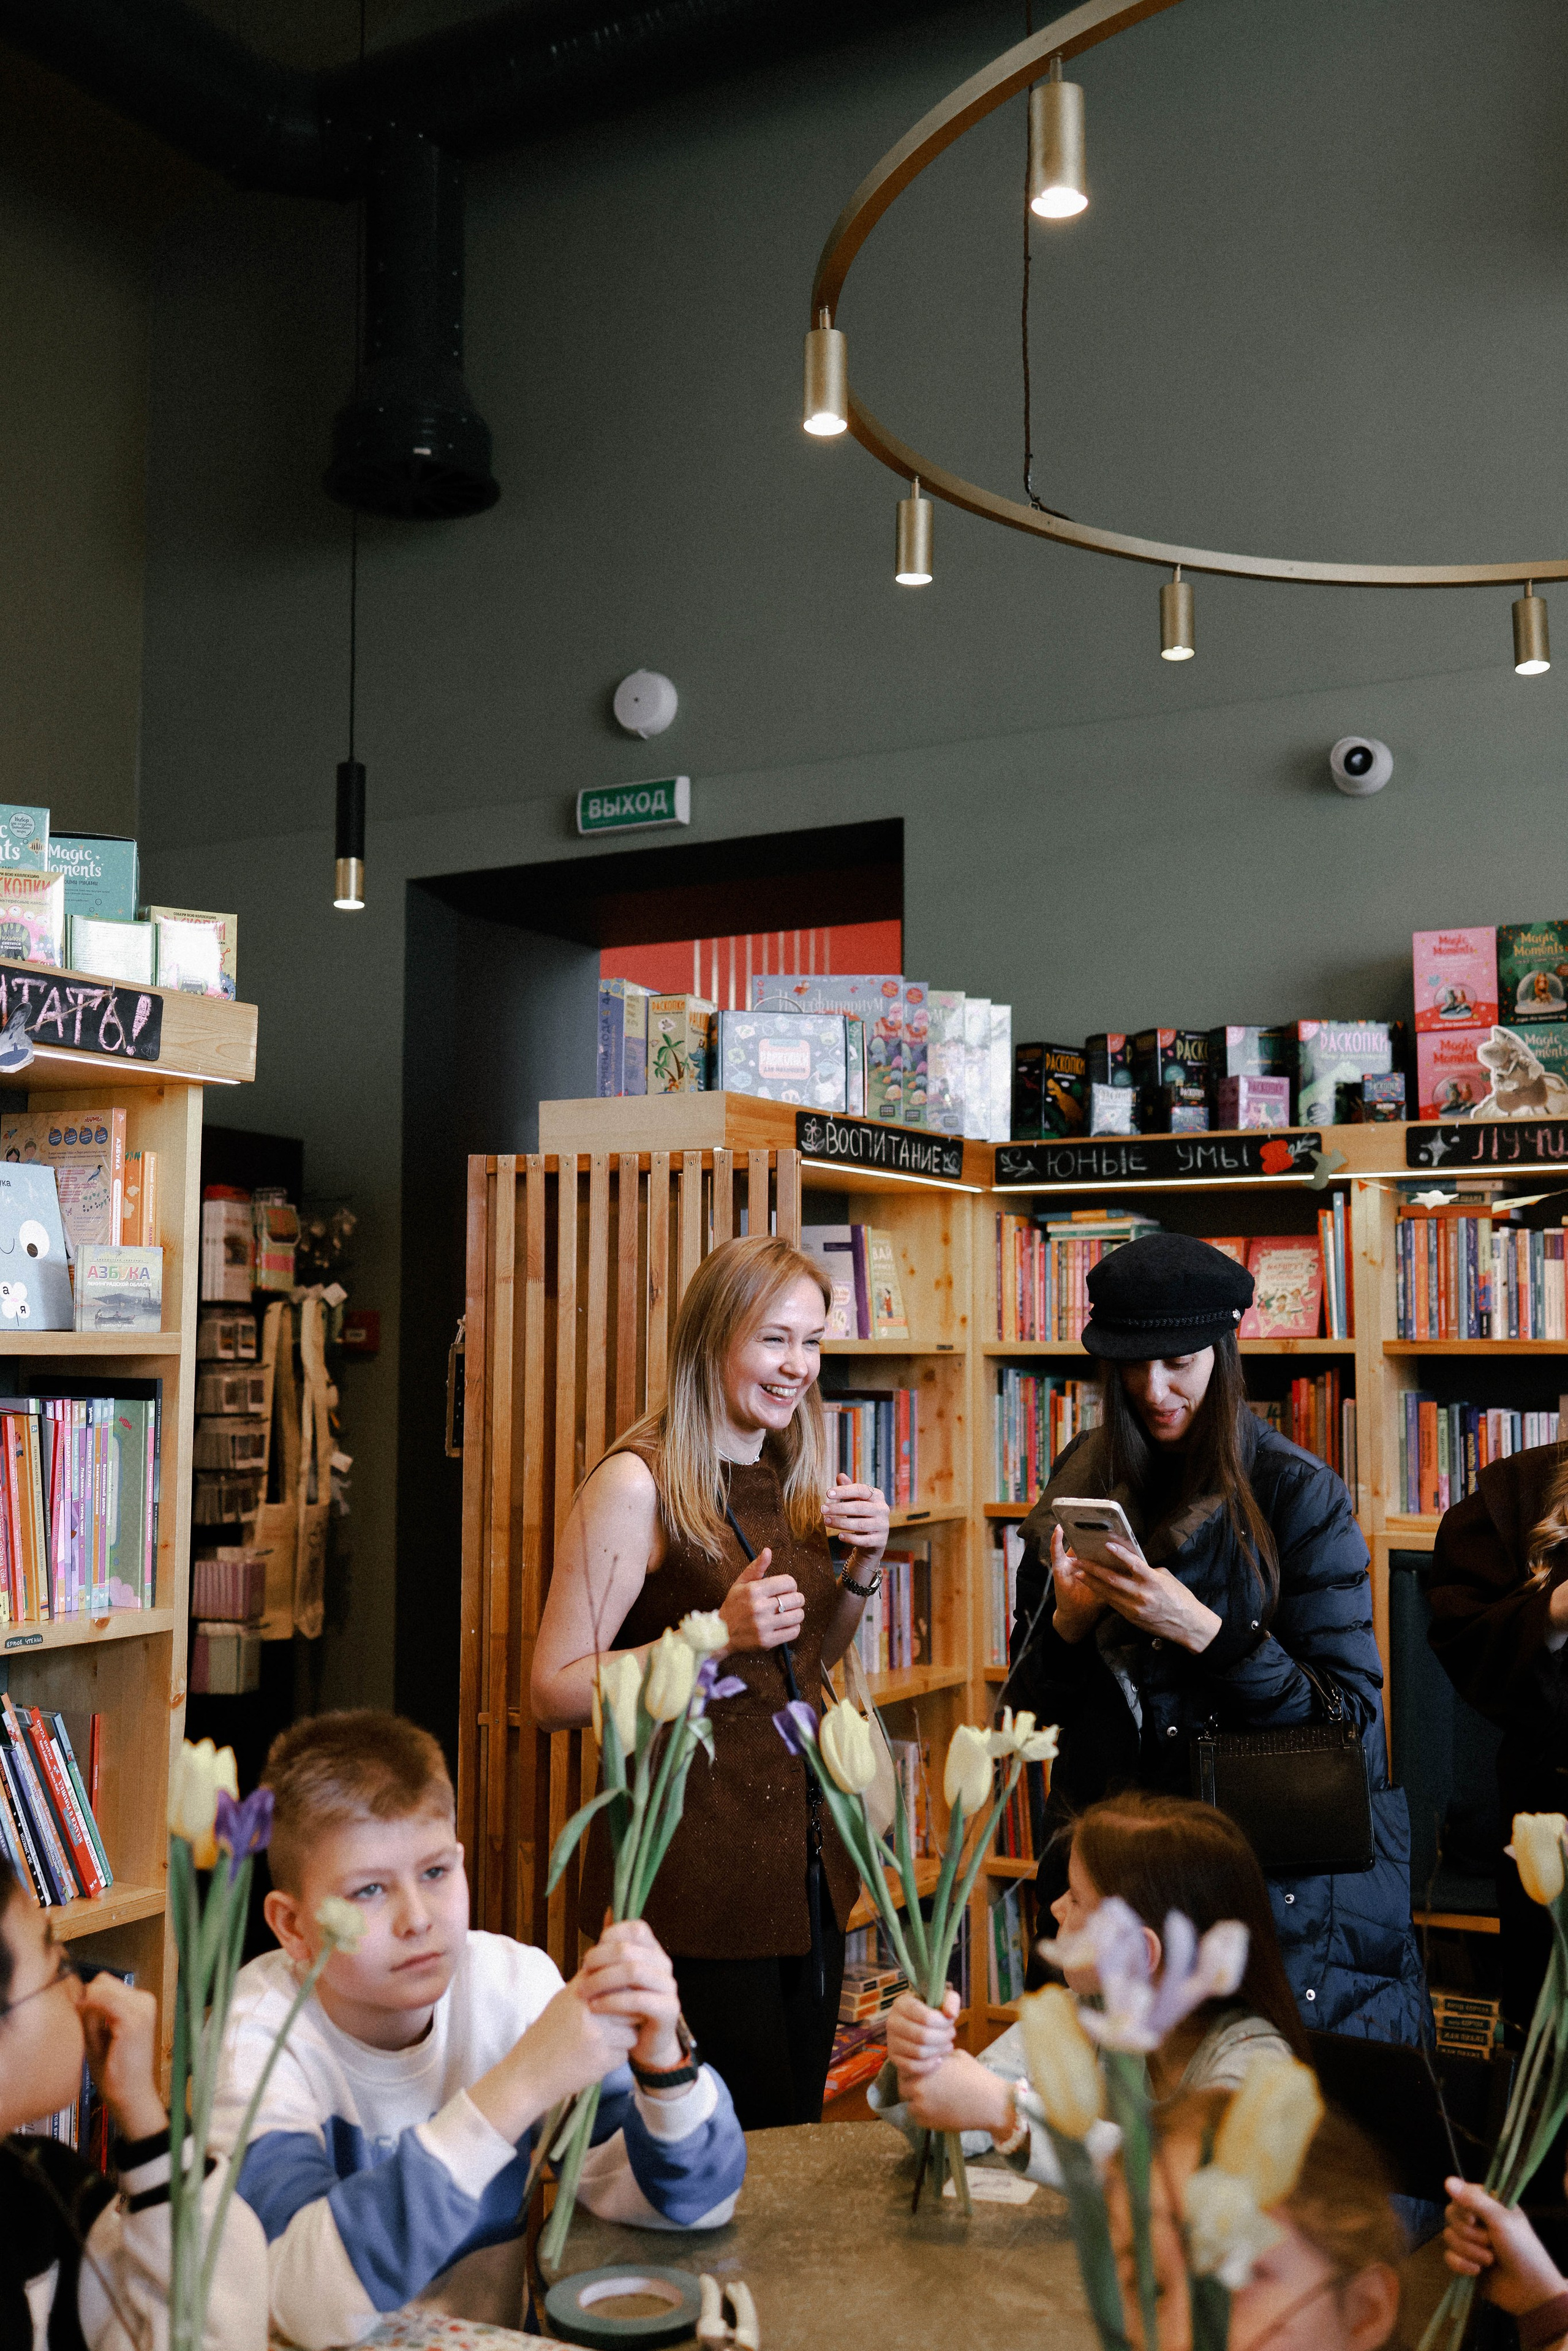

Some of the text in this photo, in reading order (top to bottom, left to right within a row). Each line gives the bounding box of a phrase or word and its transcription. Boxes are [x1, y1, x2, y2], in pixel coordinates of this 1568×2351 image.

[589, 790, 667, 819] ВЫХОД
[48, 843, 92, 865] Magic
[48, 861, 102, 878] oments
[1514, 942, 1564, 957] Moments
[1521, 932, 1556, 946] Magic
[652, 1000, 685, 1011] РАСКОПКИ
[1320, 1032, 1389, 1052] РАСКОПКИ
[1525, 1033, 1560, 1047] Magic
[1046, 1053, 1085, 1075] РАСКОПКИ
[1433, 1051, 1477, 1063] Moment
[827, 1122, 941, 1173] ВОСПИТАНИЕ
[1047, 1144, 1250, 1177] ЮНЫЕ УМЫ
[87, 1266, 150, 1280] АЗБУКА
[43, 1739, 53, 1760] АНДРЕЙ
[19, 1742, 58, 1835] Марина Байкова Рецепт Единорога
[13, 1794, 21, 1811] Крошка
[68, 1791, 80, 1813] ЧИТАЮ
[0, 1795, 20, 1842] СЪЕДОБНЫЕ СЕКРЕТЫ
[70, 1816, 84, 1844] МАЛУСЯ
[20, 1832, 29, 1854] ЭРИКСОН
[86, 1840, 100, 1871] РАННЕЕ ЧТЕНИЕ
[97, 1850, 108, 1873] Чуковский
